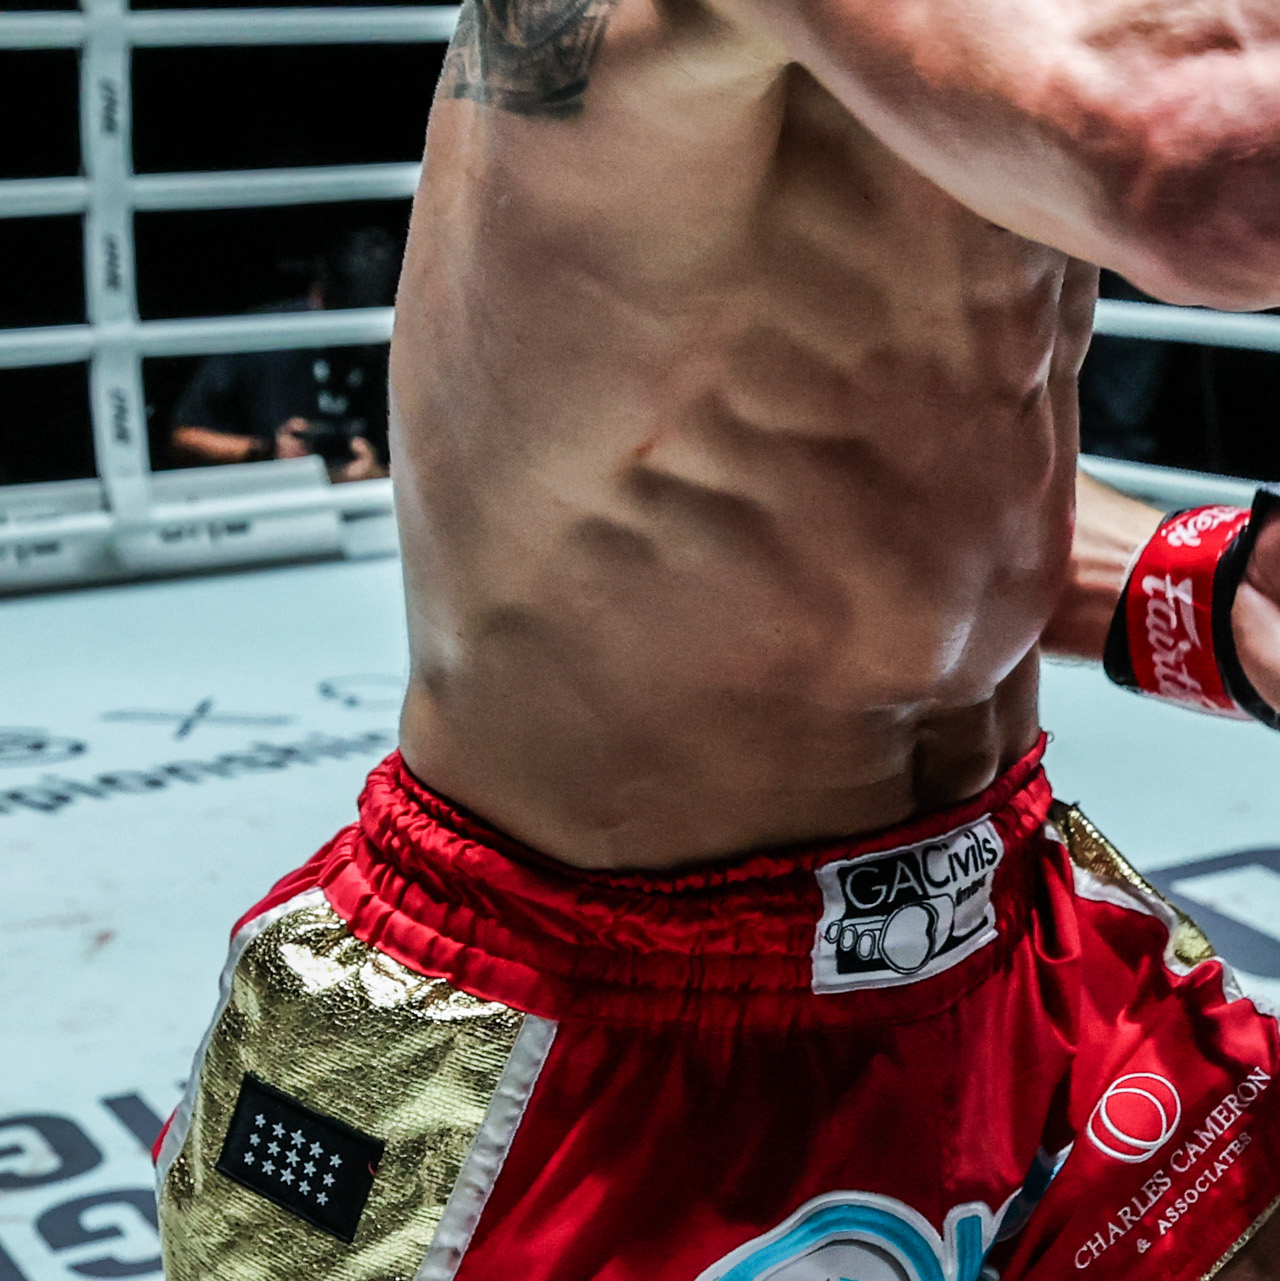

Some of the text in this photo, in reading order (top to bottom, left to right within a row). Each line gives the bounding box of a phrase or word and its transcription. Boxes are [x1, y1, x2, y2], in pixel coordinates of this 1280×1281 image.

[1073, 1066, 1272, 1270] CHARLES CAMERON
[1135, 1131, 1253, 1254] & ASSOCIATES
